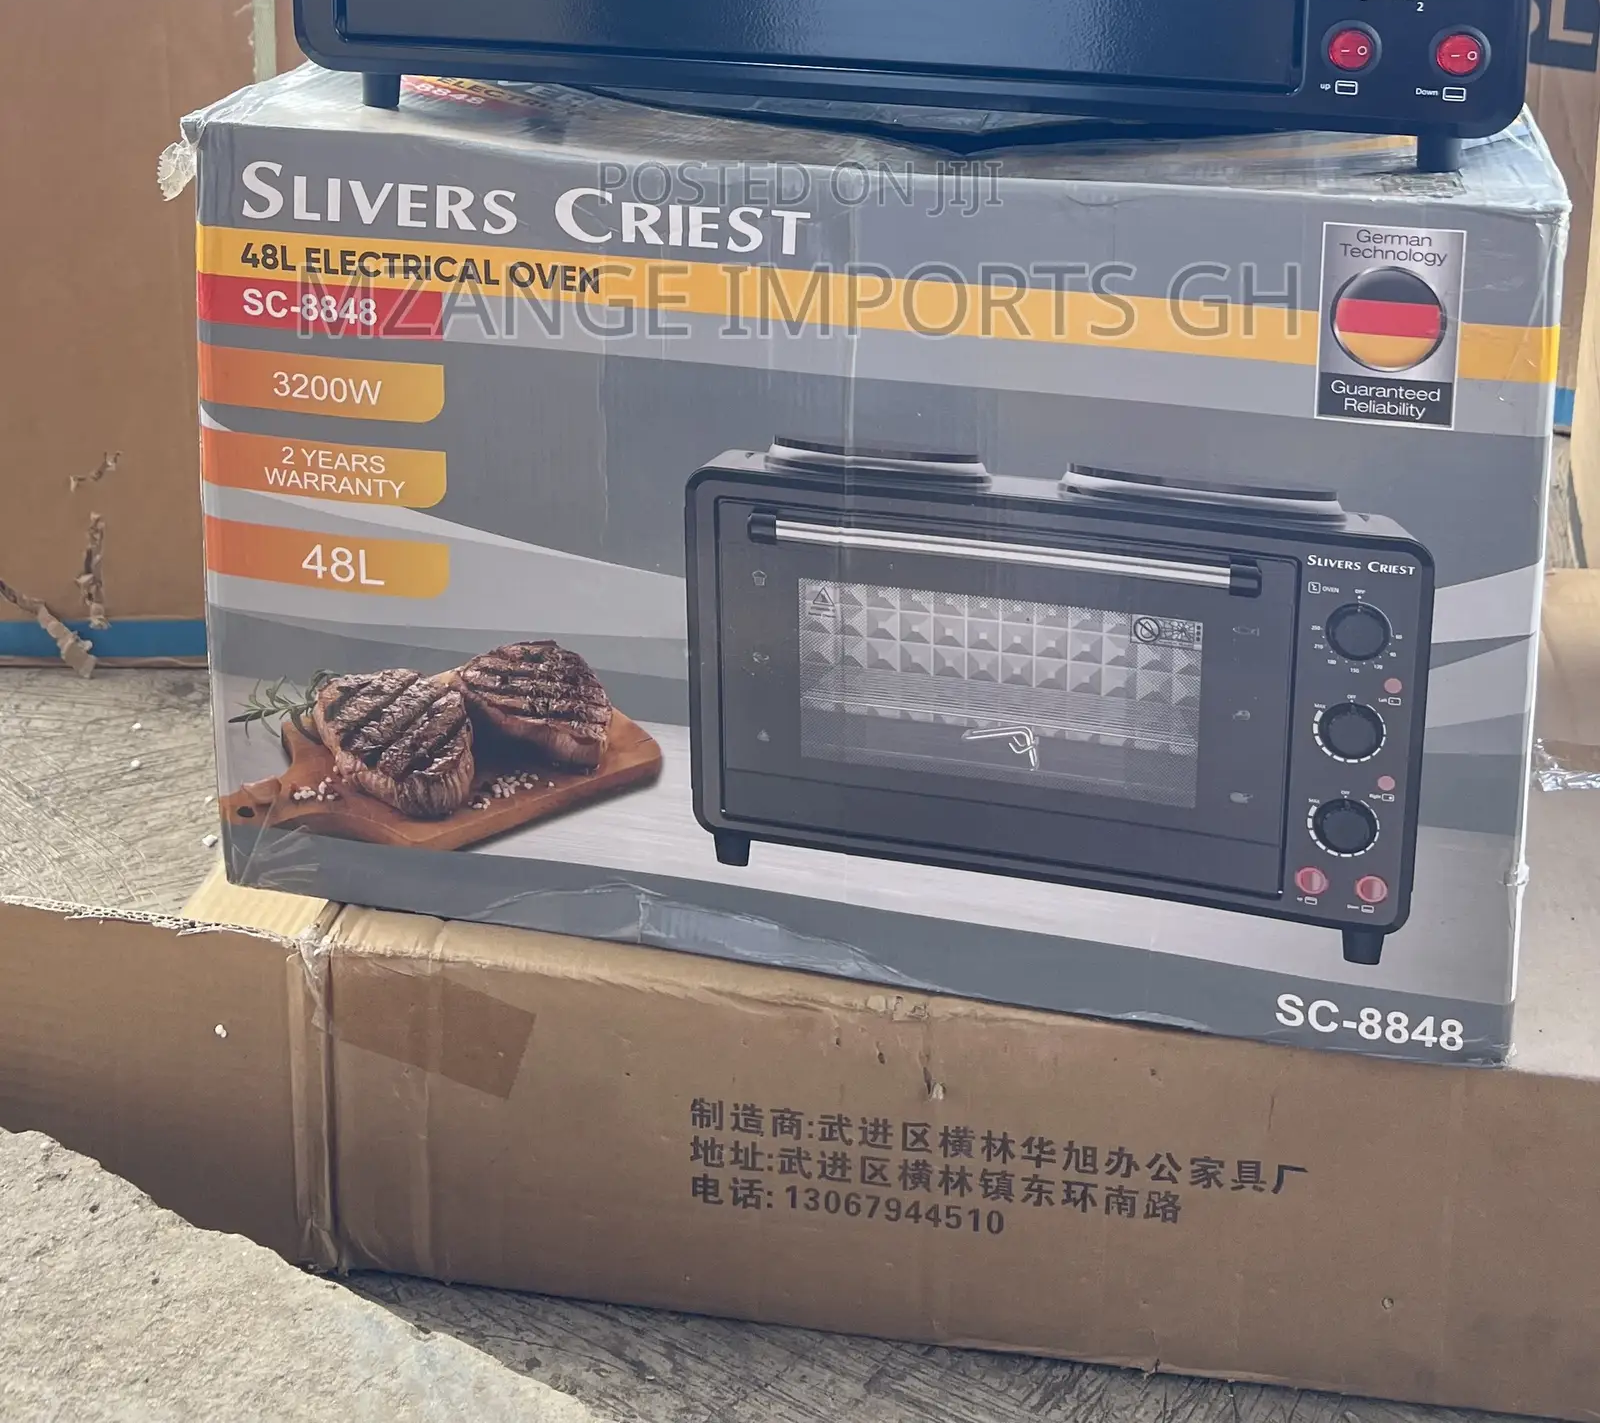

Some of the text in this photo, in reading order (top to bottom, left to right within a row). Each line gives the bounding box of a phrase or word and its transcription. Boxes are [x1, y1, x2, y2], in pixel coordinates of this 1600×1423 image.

[1416, 1, 1424, 12] 2
[1415, 87, 1438, 96] Down
[240, 161, 811, 256] SLIVERS CRIEST
[1355, 228, 1434, 249] German
[240, 242, 602, 294] 48L ELECTRICAL OVEN
[1339, 242, 1448, 267] Technology
[242, 289, 379, 326] SC-8848
[272, 370, 383, 406] 3200W
[1330, 379, 1441, 403] Guaranteed
[1342, 396, 1427, 421] Reliability
[281, 446, 386, 474] 2 YEARS
[264, 467, 406, 499] WARRANTY
[301, 545, 386, 586] 48L
[1307, 555, 1415, 575] SLIVERS CRIEST
[1275, 993, 1464, 1052] SC-8848
[690, 1136, 1183, 1225] 地址:武进区横林镇东环南路
